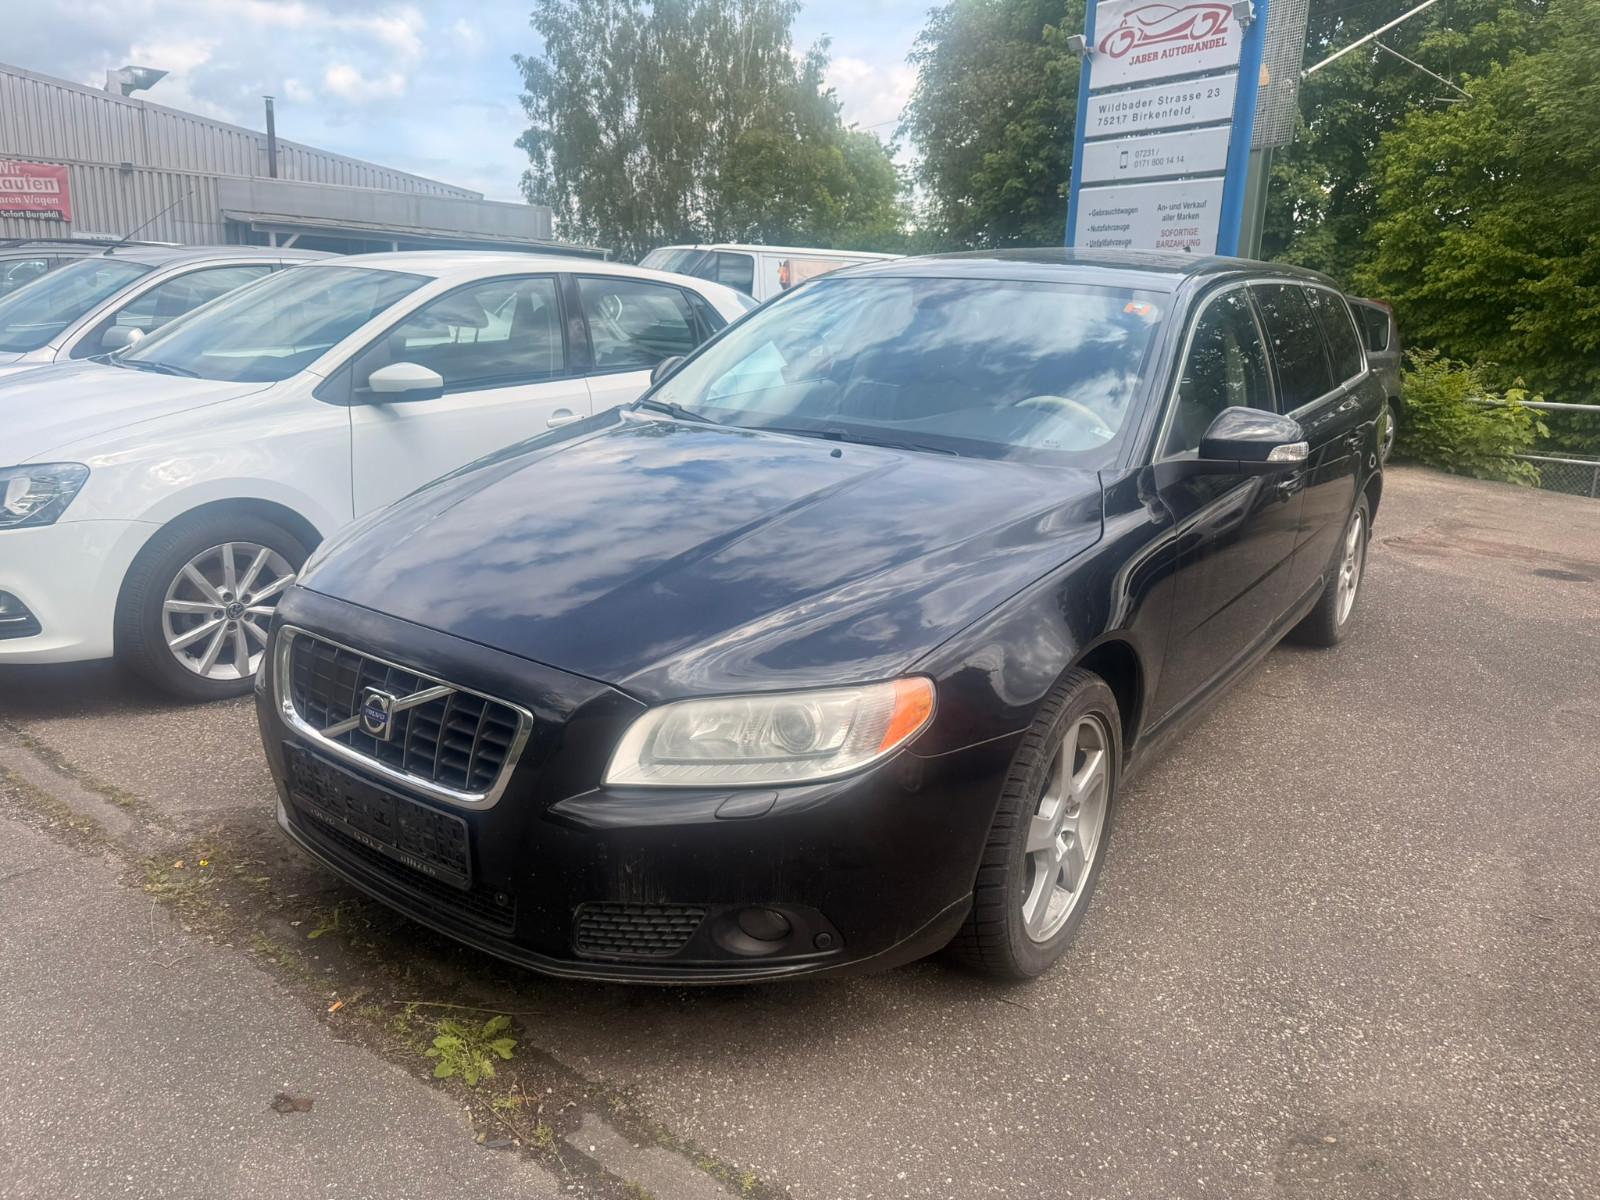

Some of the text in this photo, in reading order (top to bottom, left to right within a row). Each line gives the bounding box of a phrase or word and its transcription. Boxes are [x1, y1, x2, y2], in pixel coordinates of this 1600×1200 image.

[1129, 37, 1227, 66] JABER AUTOHANDEL
[1098, 87, 1221, 114] Wildbader Strasse 23
[1097, 105, 1192, 127] 75217 Birkenfeld
[0, 173, 56, 191] aufen
[23, 194, 59, 206] Wagen
[1, 210, 24, 218] Sofort
[1160, 227, 1199, 238] SOFORTIGE
